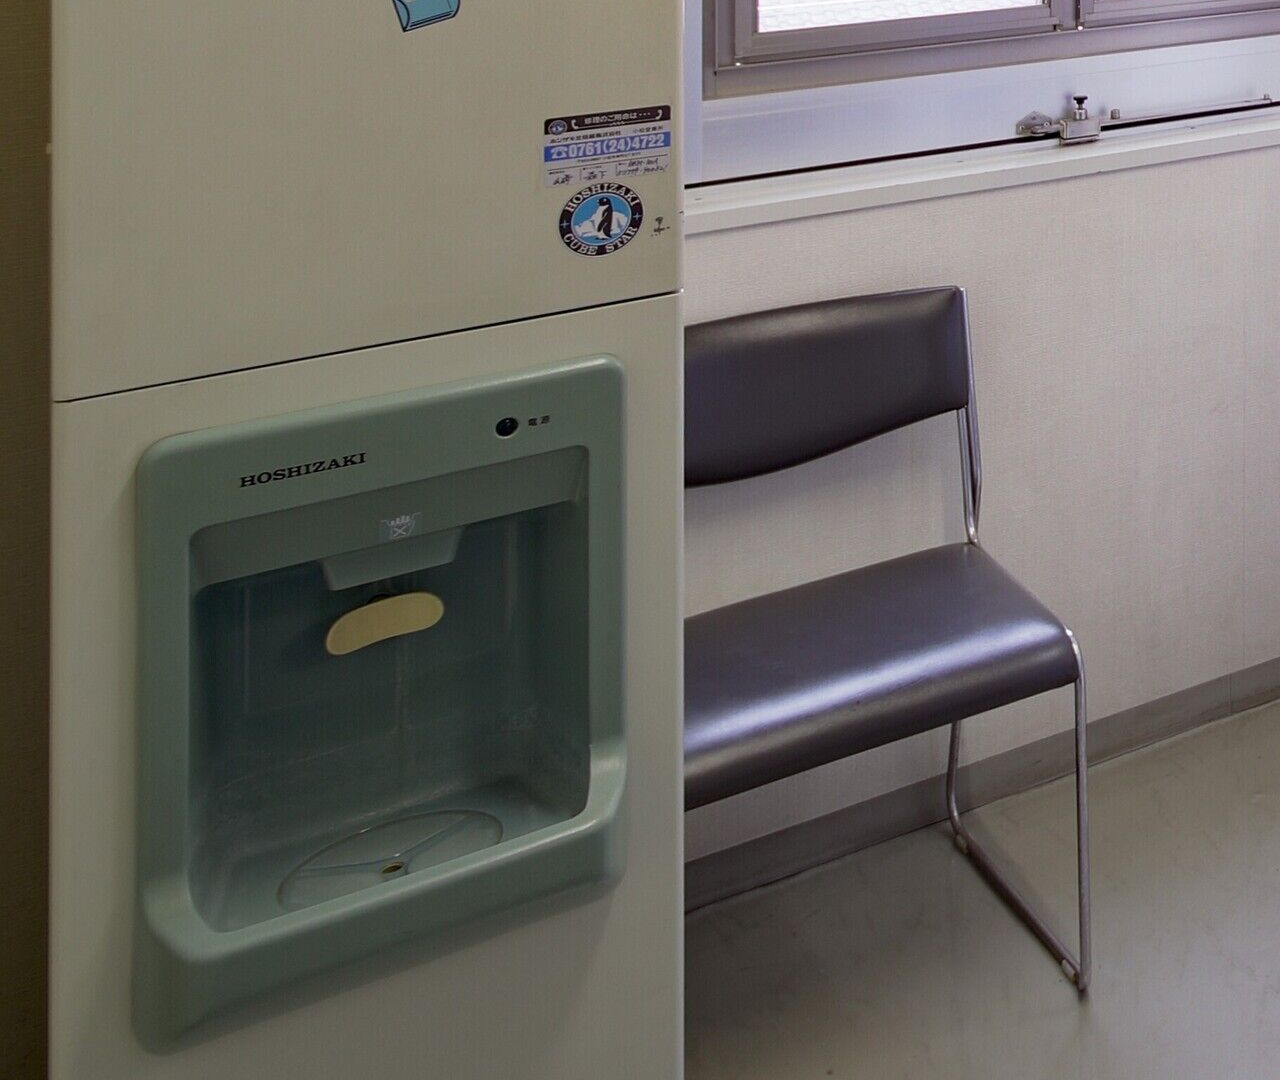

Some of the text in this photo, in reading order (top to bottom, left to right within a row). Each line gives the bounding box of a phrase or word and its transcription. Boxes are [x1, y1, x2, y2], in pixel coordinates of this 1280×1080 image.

[568, 134, 665, 158] 0761(24)4722
[564, 183, 640, 213] HOSHIZAKI
[563, 226, 638, 256] CUBE STAR
[239, 452, 367, 488] HOSHIZAKI
